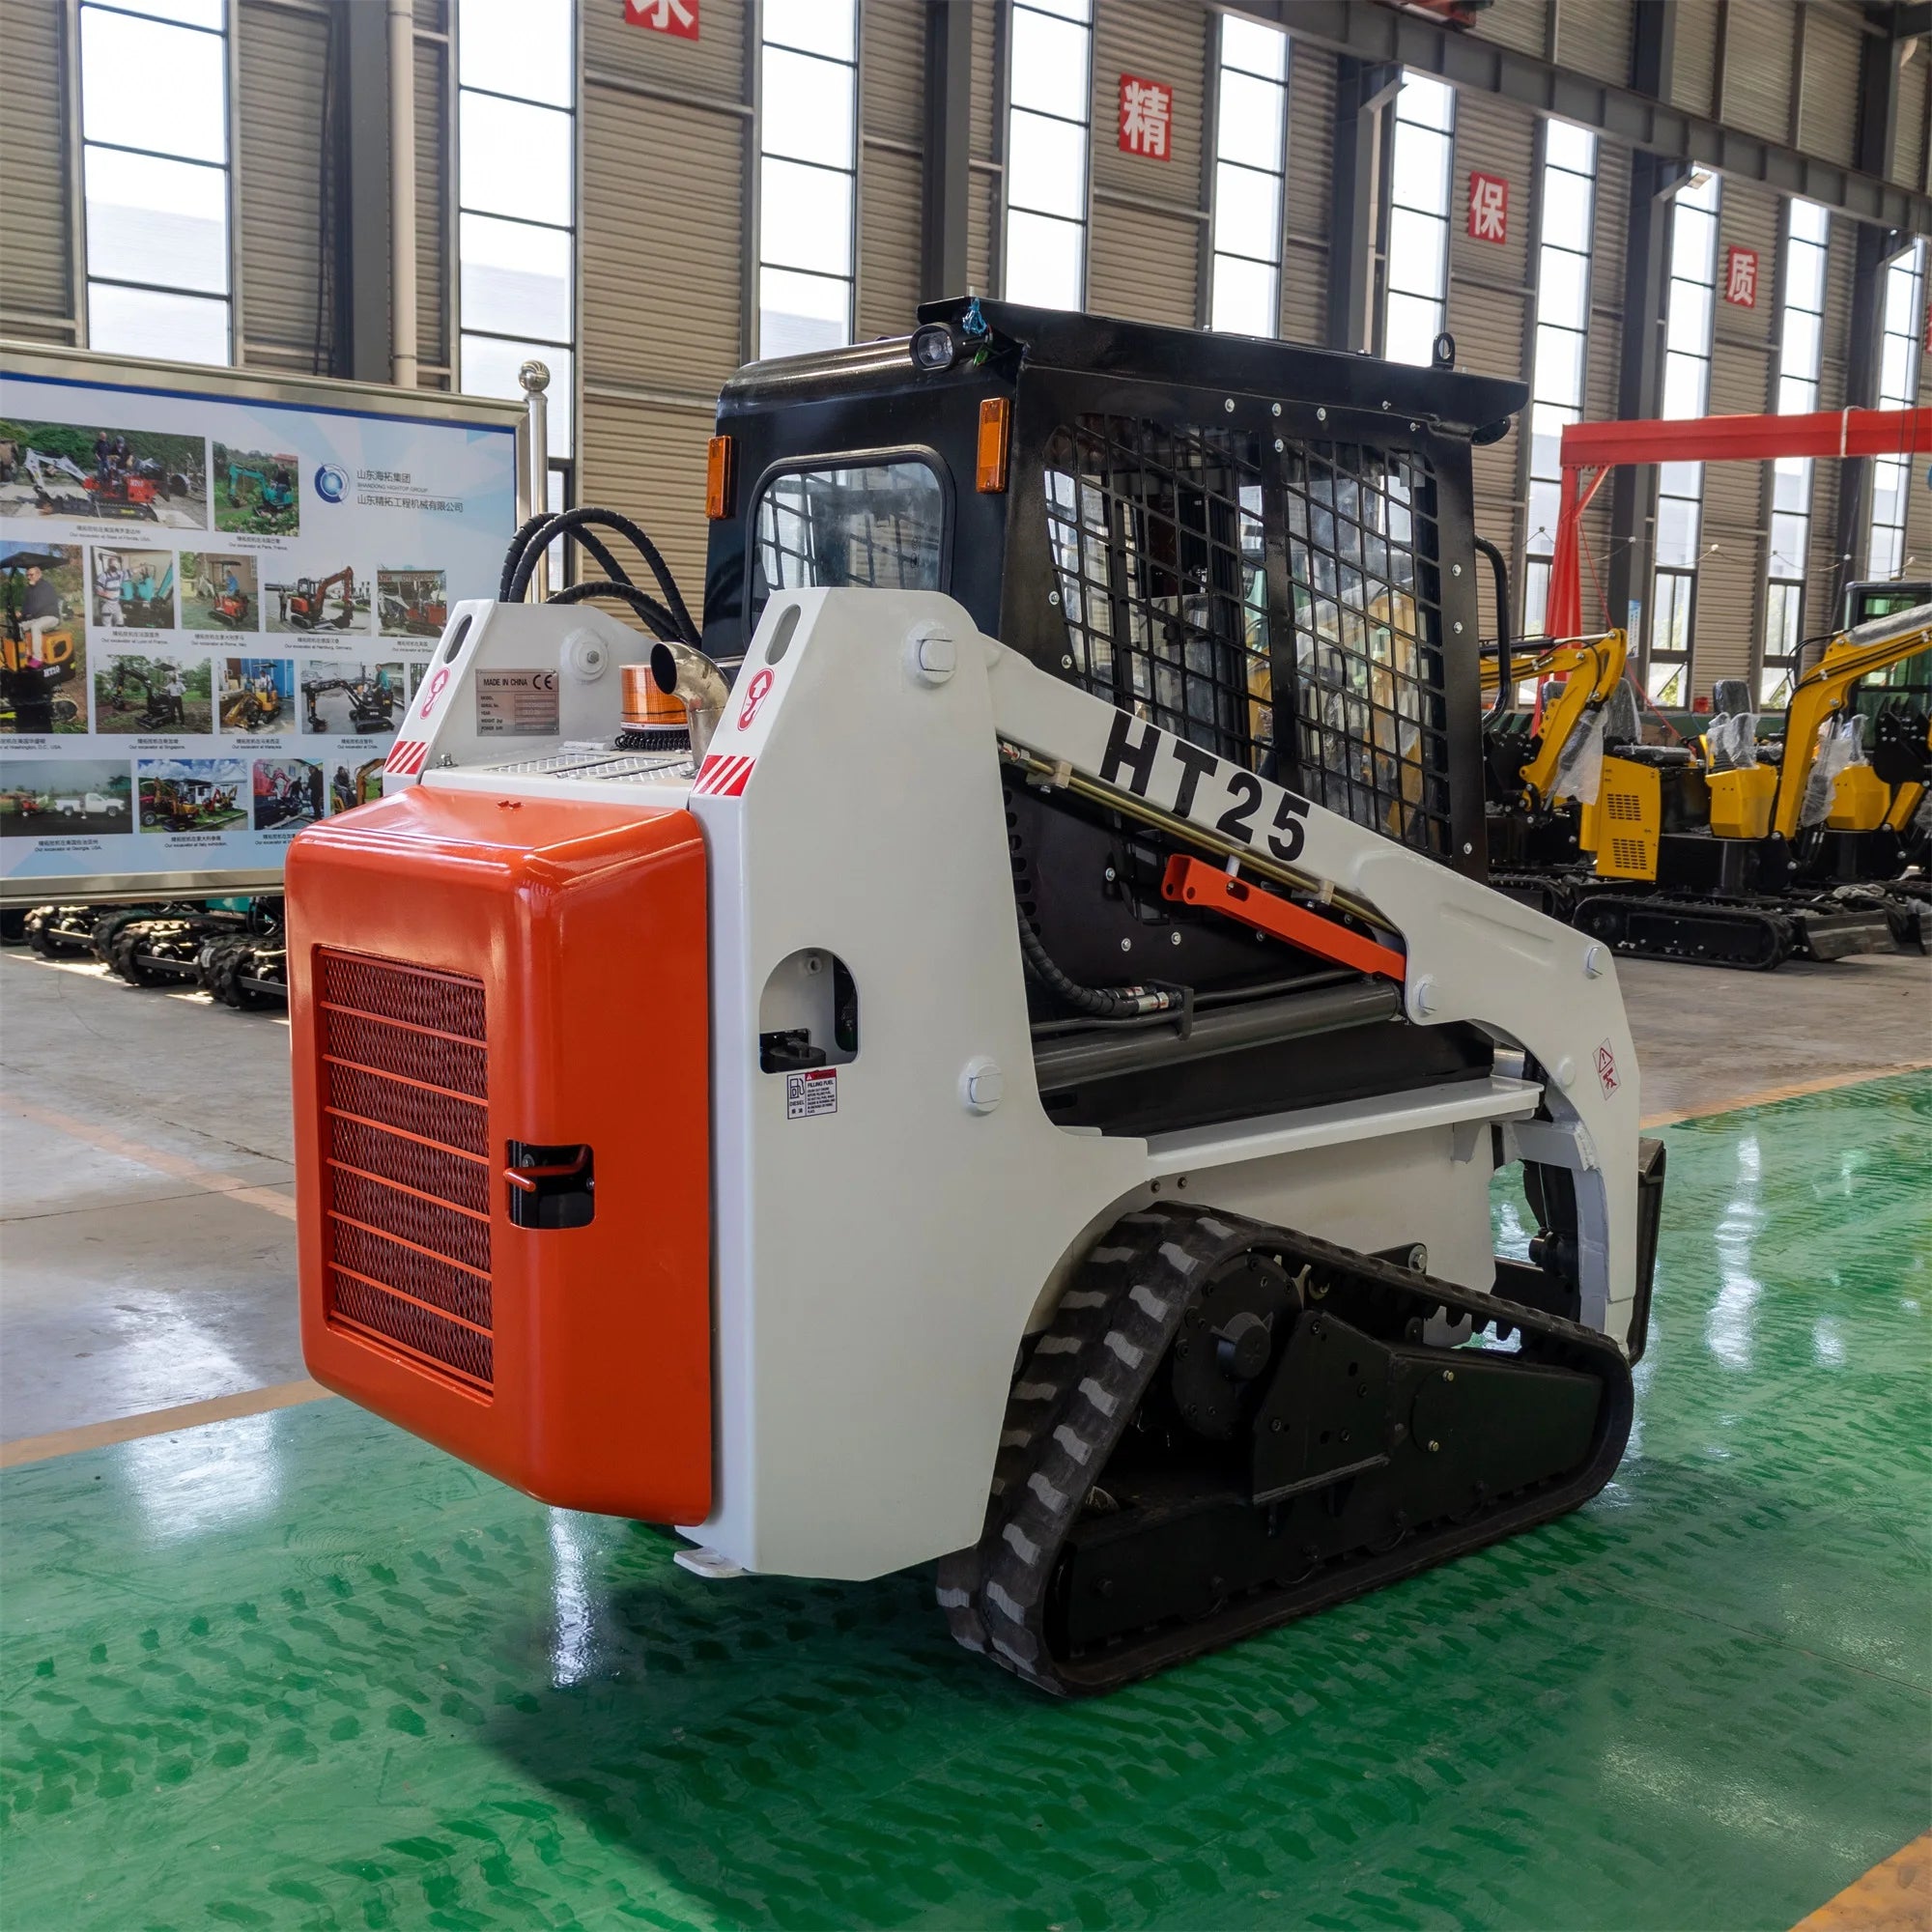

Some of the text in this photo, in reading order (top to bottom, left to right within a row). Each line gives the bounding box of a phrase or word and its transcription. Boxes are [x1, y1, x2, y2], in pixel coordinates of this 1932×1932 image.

[1123, 81, 1169, 156] 精
[1471, 177, 1504, 239] 保
[1728, 253, 1755, 305] 质
[357, 469, 411, 483] 山东海拓集团
[357, 495, 464, 513] 山东精拓工程机械有限公司
[533, 674, 553, 690] CE
[1098, 709, 1311, 862] HT25
